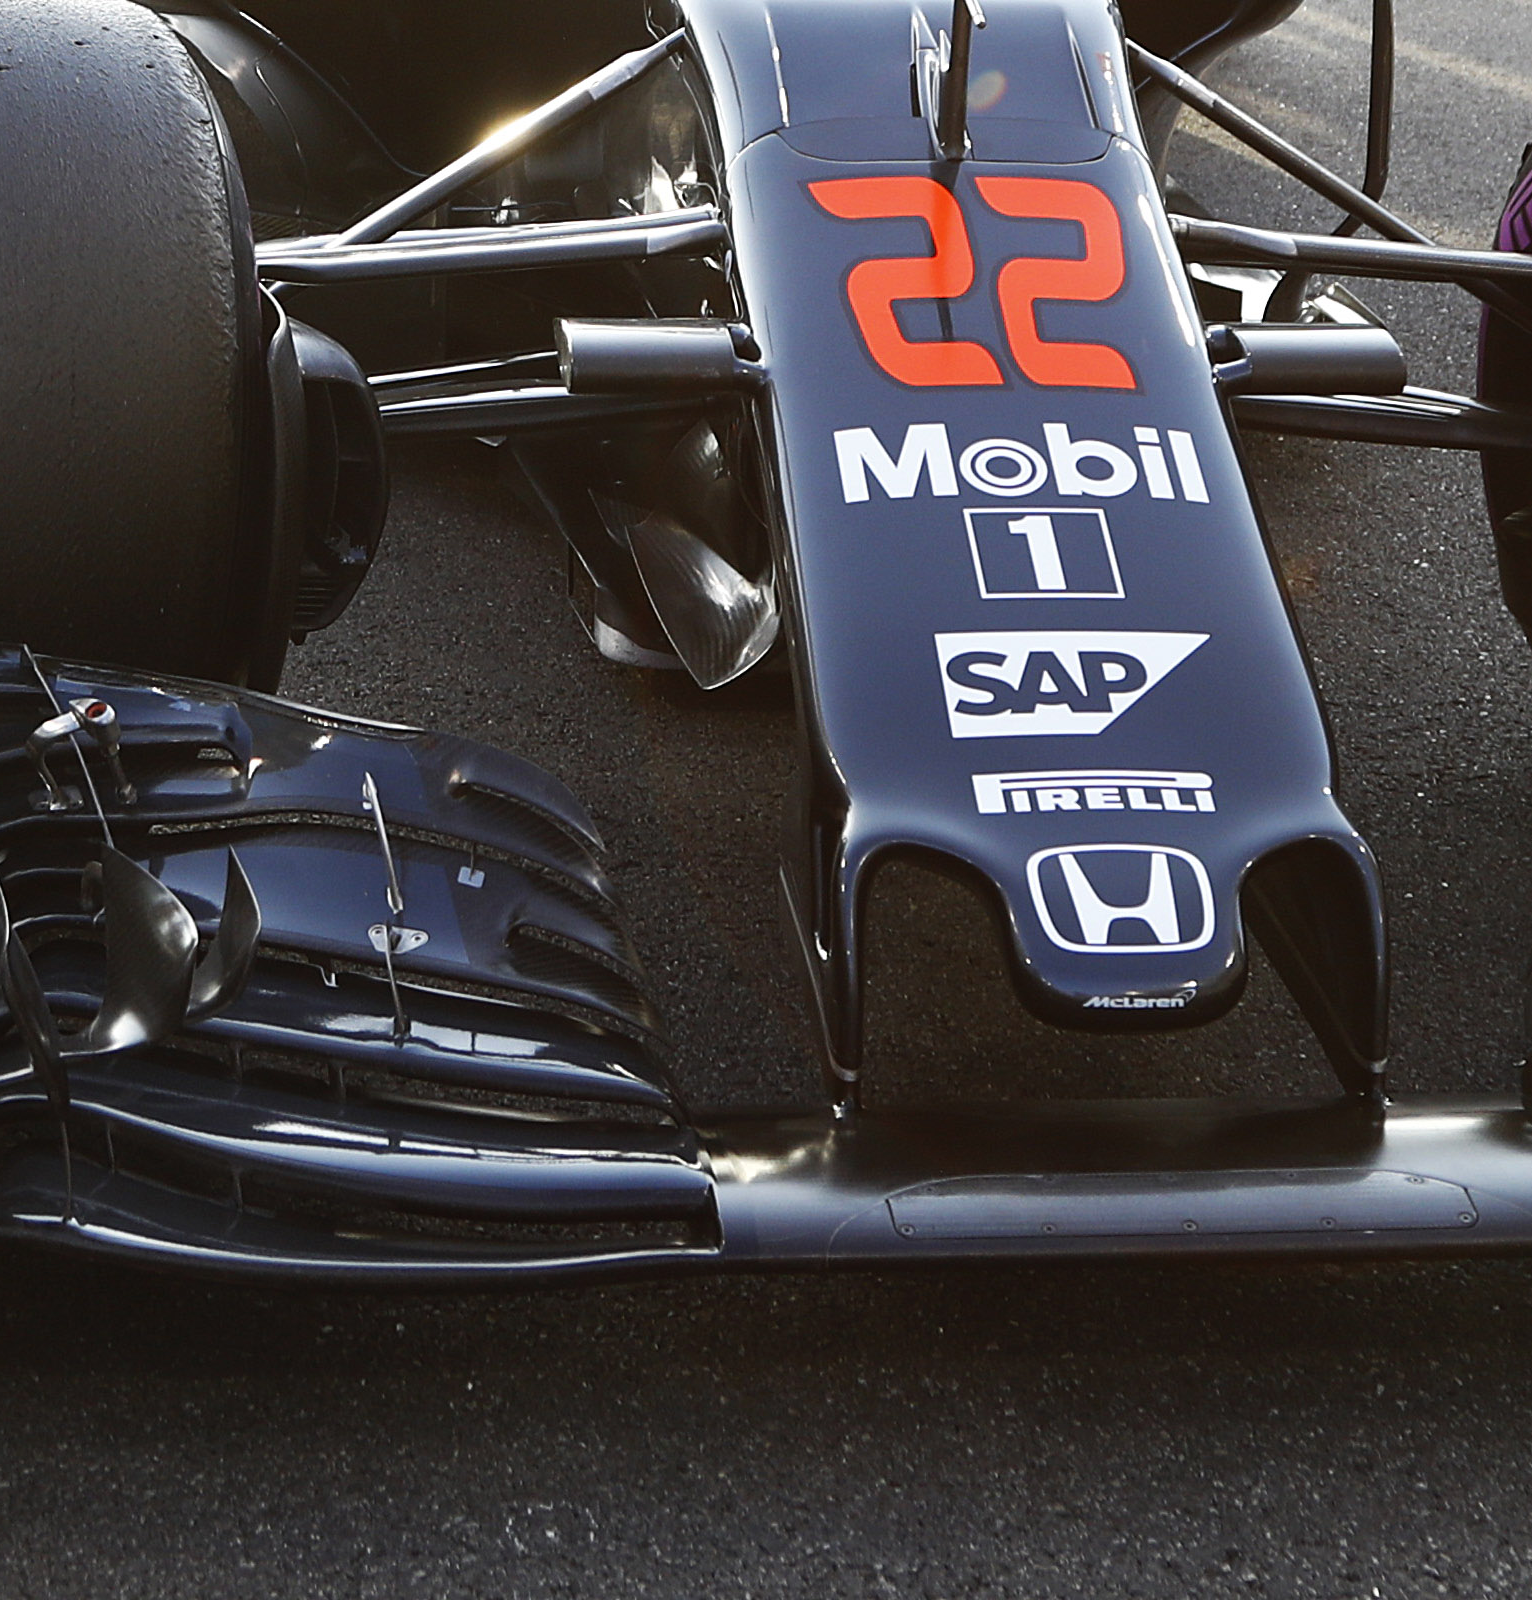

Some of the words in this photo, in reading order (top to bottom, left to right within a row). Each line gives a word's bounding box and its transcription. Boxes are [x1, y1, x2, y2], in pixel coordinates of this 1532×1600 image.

[807, 175, 1137, 389] 22
[833, 423, 1210, 504] Mobil
[946, 651, 1148, 716] SAP
[971, 770, 1217, 813] PIRELLI
[1083, 996, 1185, 1008] McLaren
